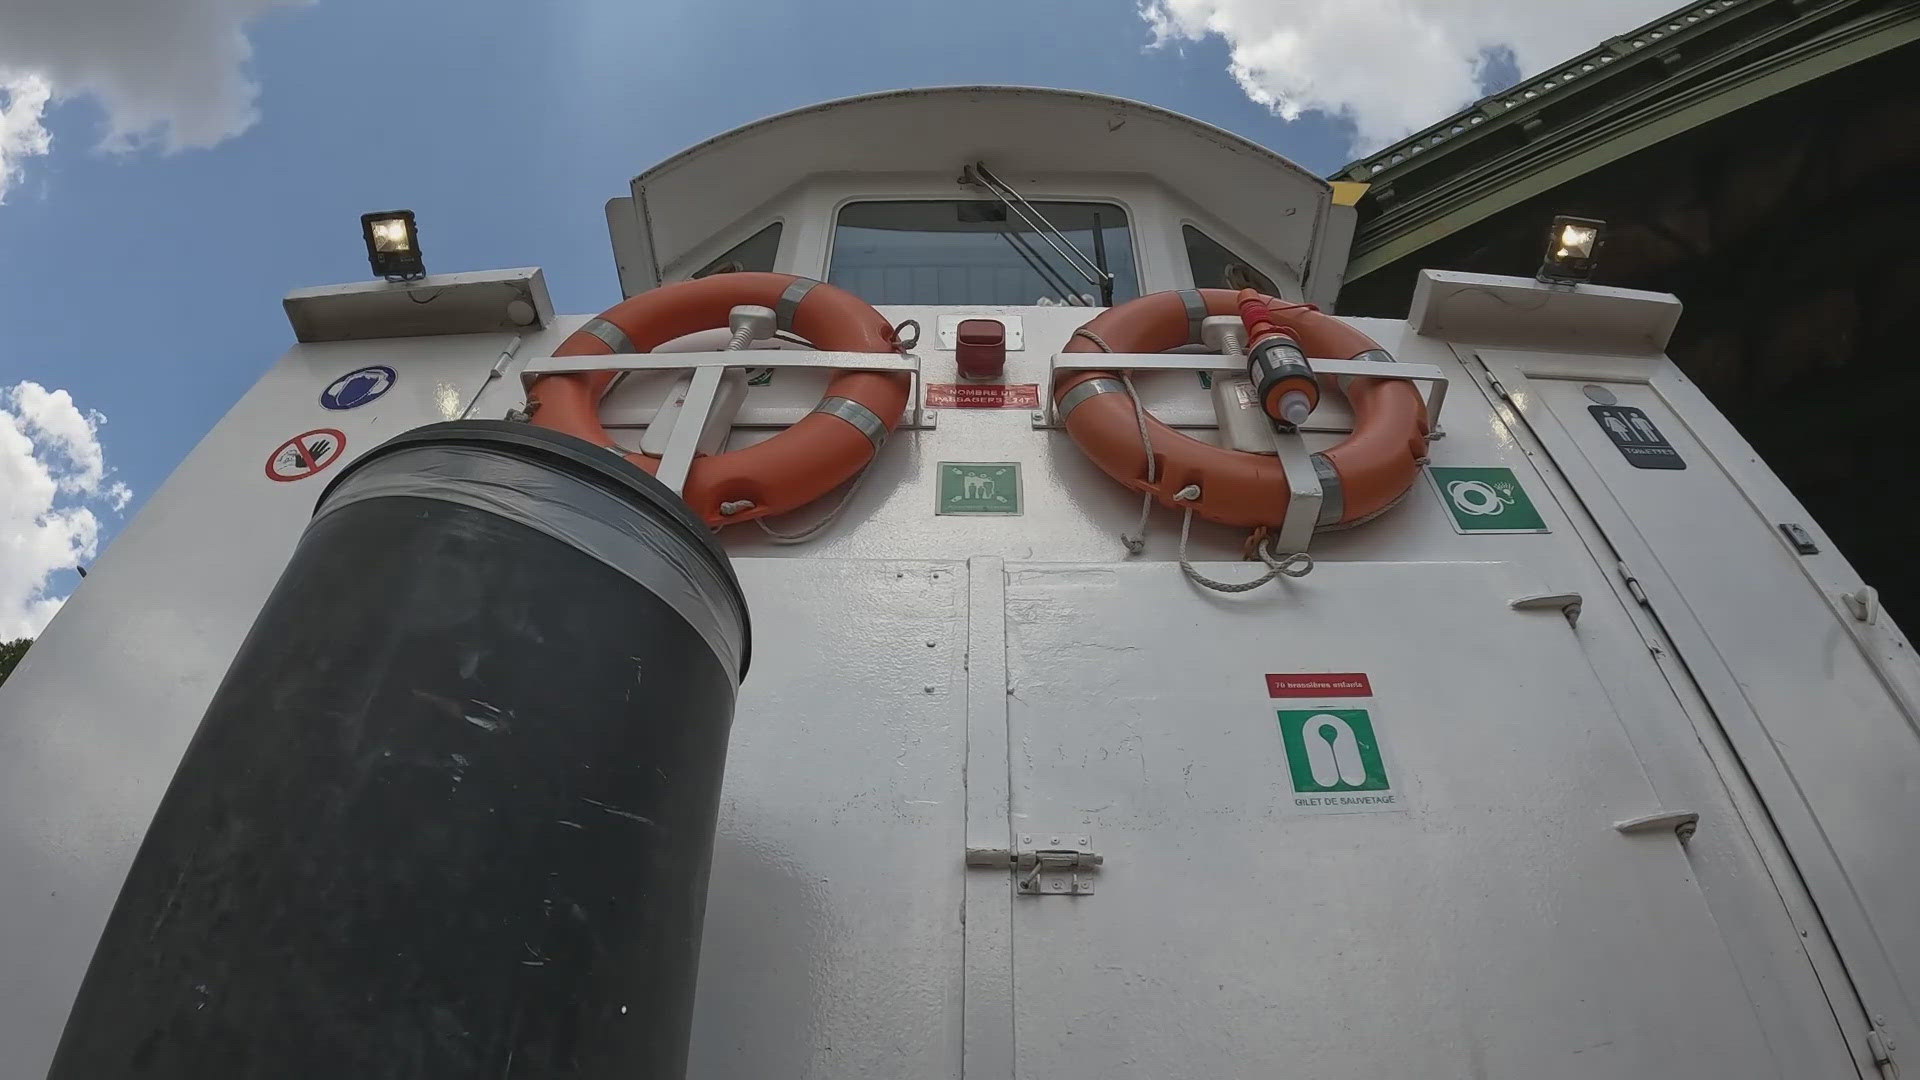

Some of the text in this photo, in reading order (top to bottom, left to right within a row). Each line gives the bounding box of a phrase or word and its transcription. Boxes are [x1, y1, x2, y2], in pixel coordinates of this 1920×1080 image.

[1001, 389, 1017, 397] DE
[934, 396, 1003, 404] PASSAGERS
[1624, 447, 1675, 455] TOILETTES
[1295, 795, 1396, 806] GILET DE SAUVETAGE
